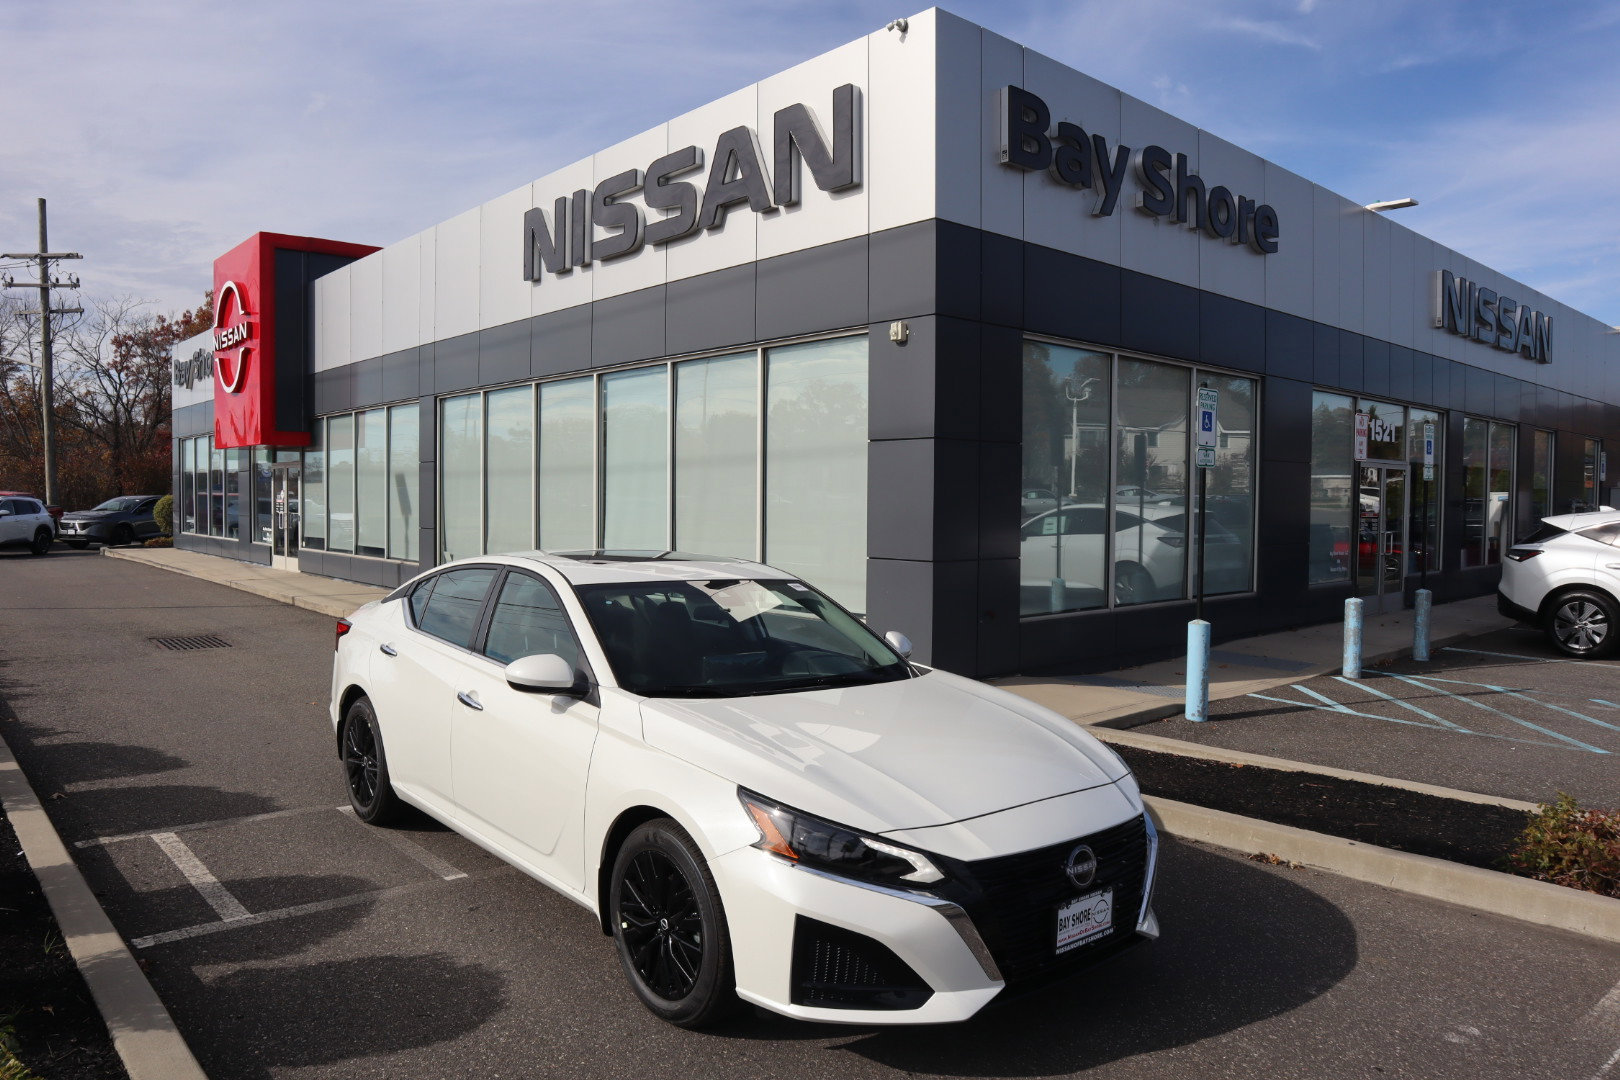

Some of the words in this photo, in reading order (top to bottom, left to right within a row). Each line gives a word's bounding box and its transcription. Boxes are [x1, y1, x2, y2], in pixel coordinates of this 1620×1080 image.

[523, 83, 861, 282] NISSAN
[1001, 85, 1131, 216] Bay
[1135, 145, 1280, 254] Shore
[1437, 269, 1553, 364] NISSAN
[213, 321, 247, 351] NISSAN
[174, 359, 194, 390] Bay
[1200, 401, 1216, 411] PARKING
[1370, 419, 1396, 443] 1521
[1066, 861, 1097, 875] NISSAN
[1058, 915, 1071, 932] BAY
[1071, 908, 1092, 927] SHORE
